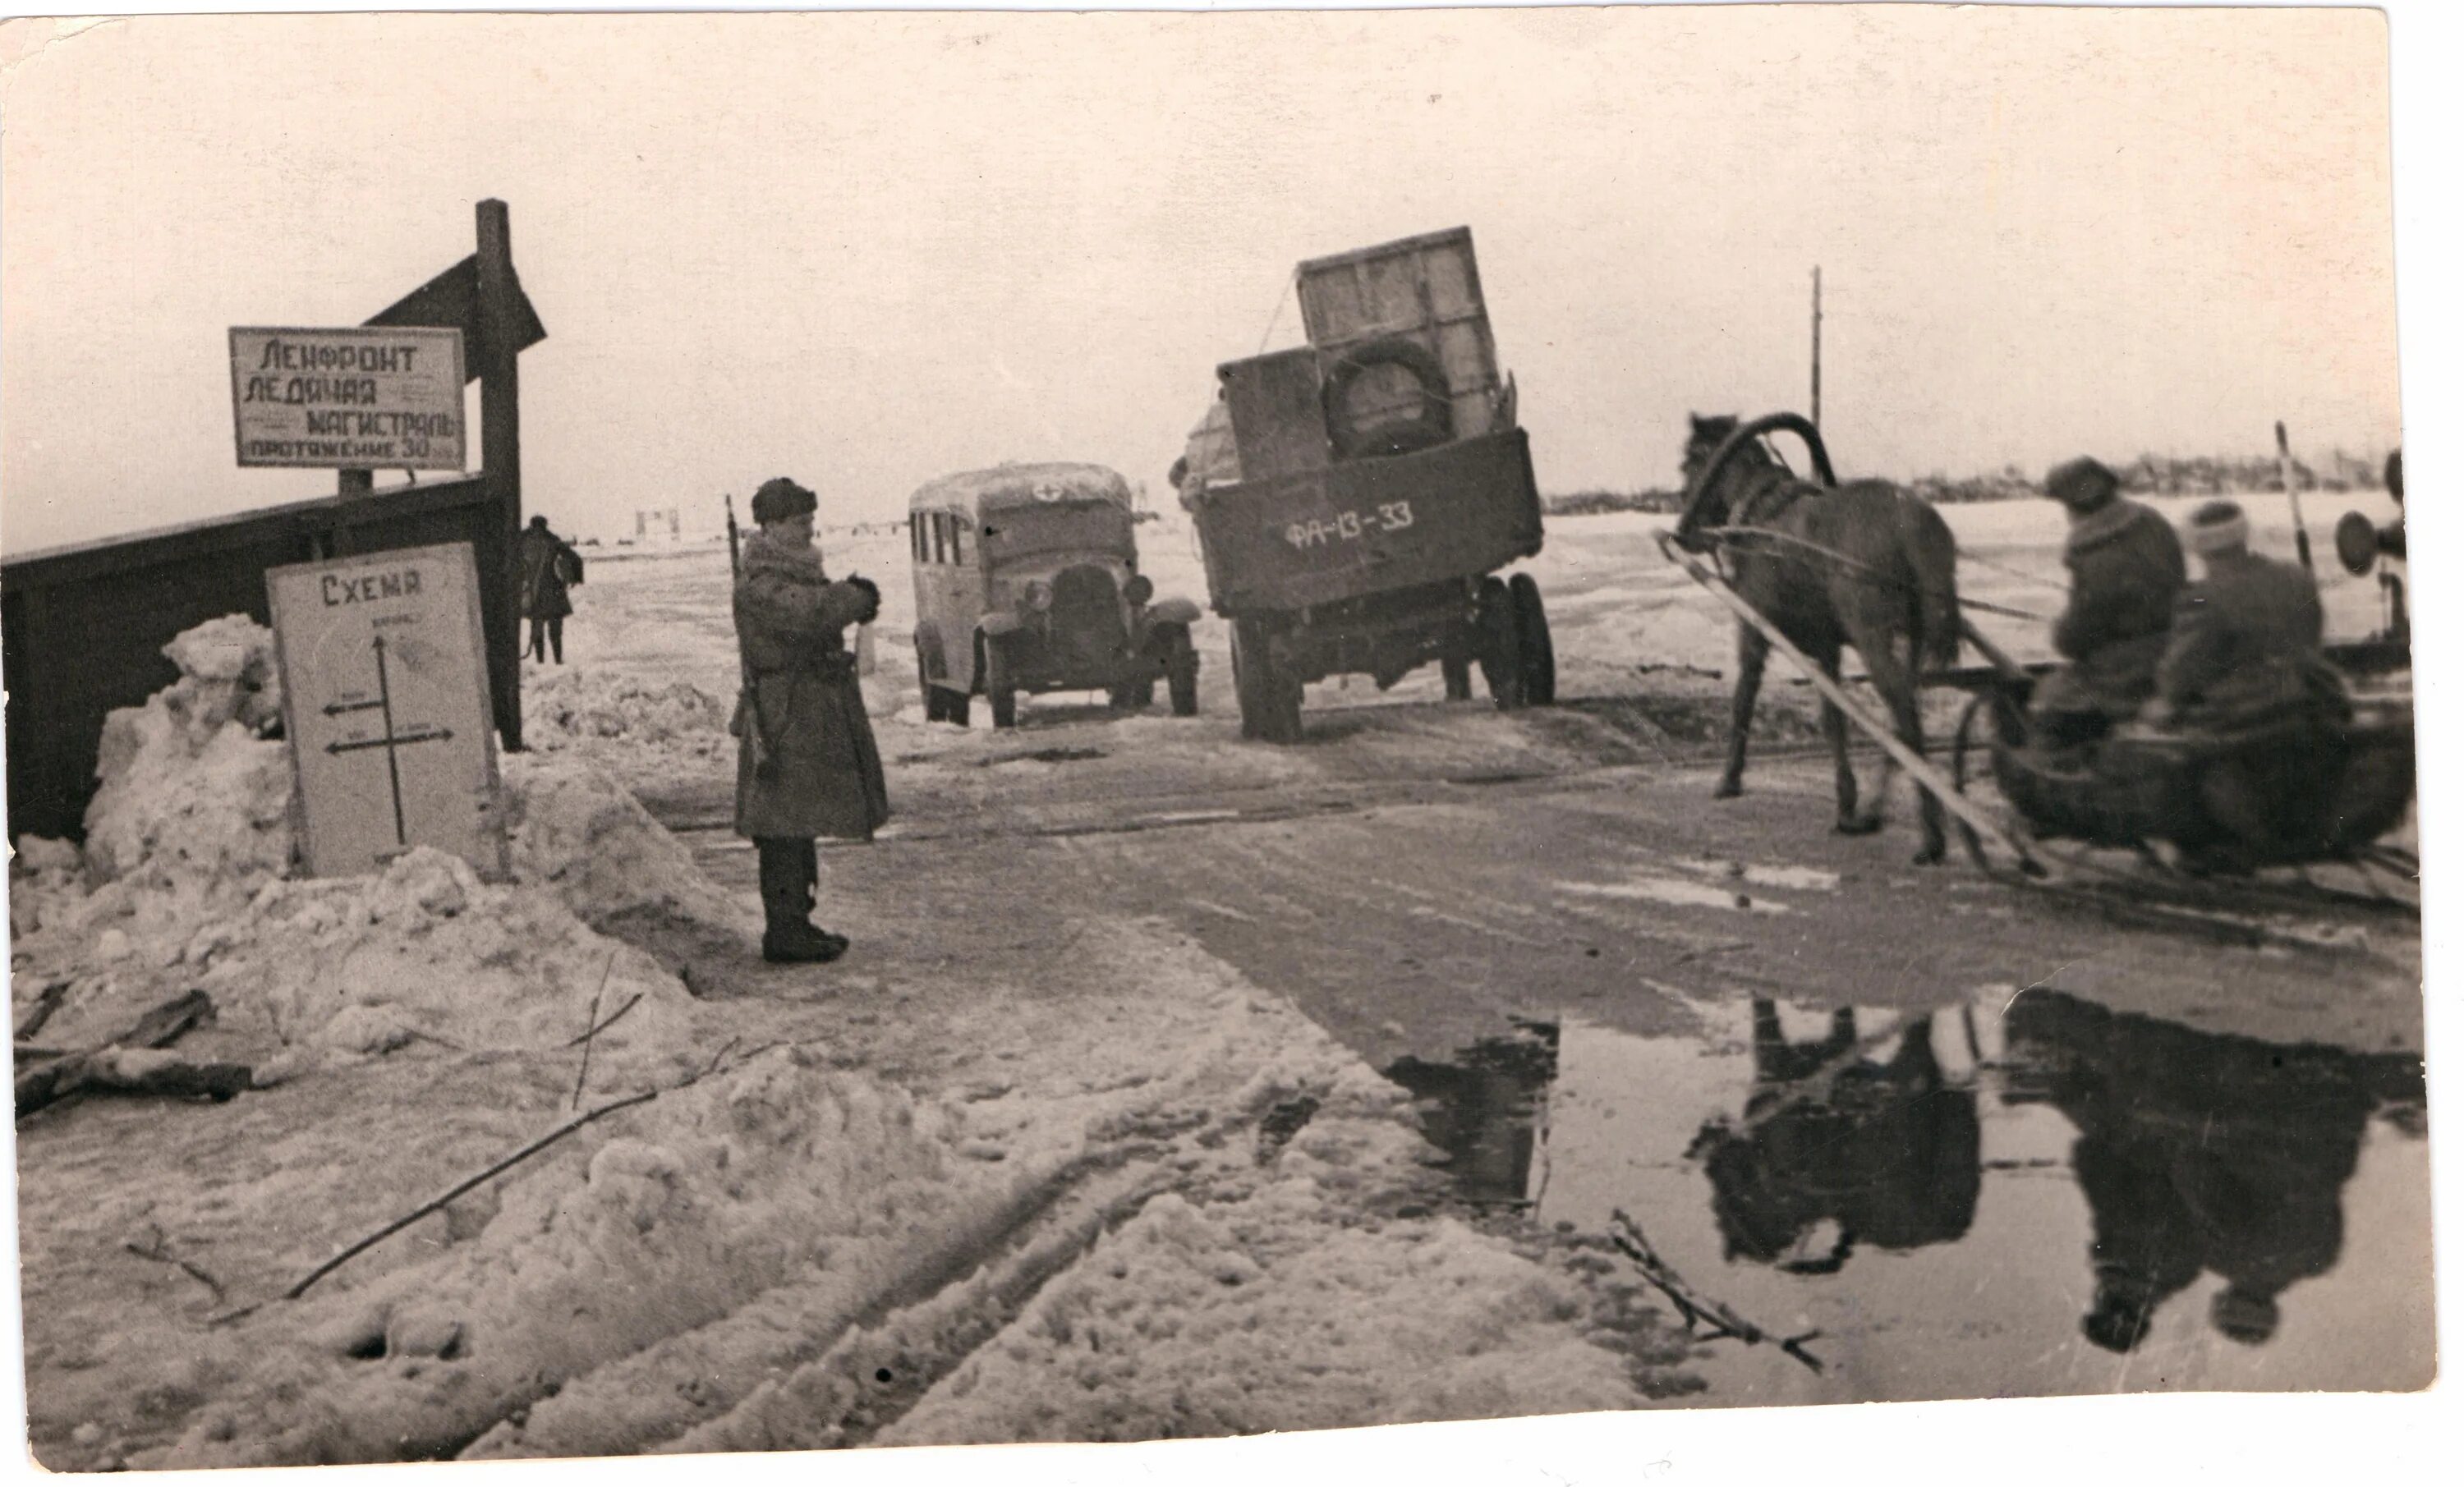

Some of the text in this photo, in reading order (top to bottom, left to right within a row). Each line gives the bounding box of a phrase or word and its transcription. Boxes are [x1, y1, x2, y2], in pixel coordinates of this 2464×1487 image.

[260, 338, 417, 371] ЛЕНФРОНТ
[306, 411, 454, 437] МАГИСТРАЛЬ
[1286, 501, 1414, 548] ФА-13-33
